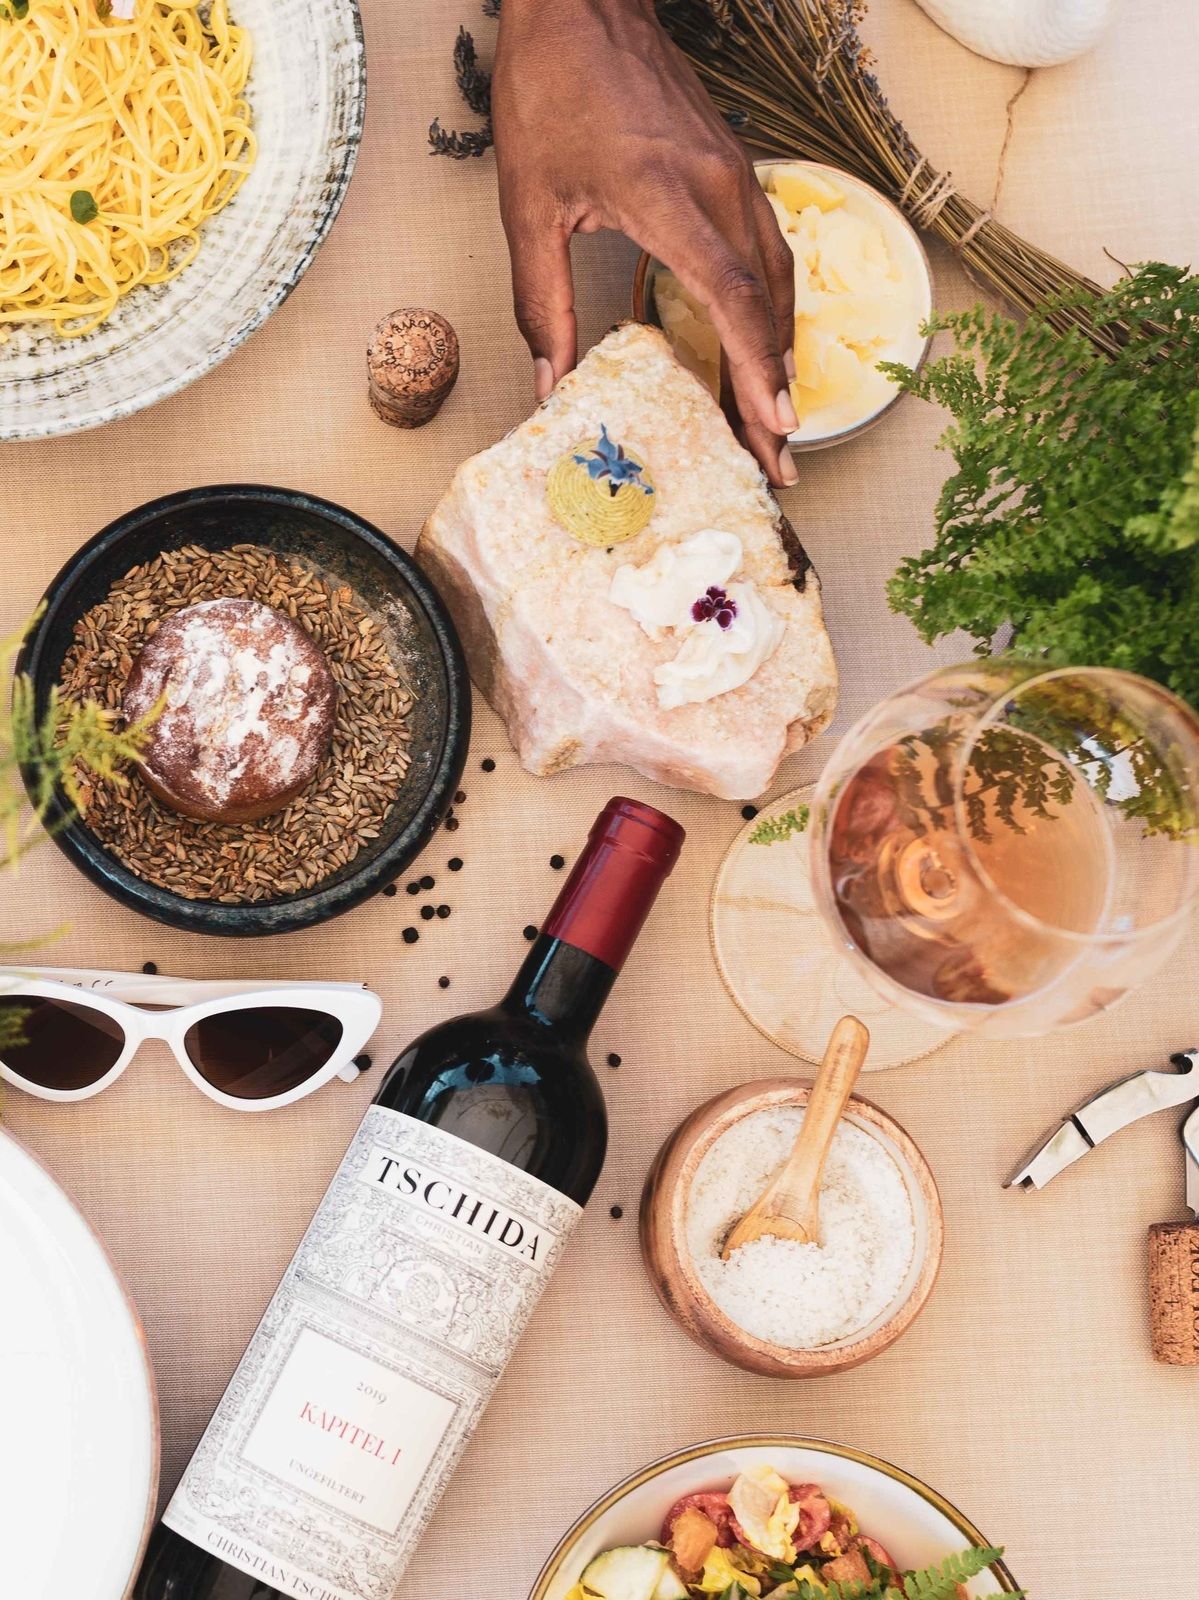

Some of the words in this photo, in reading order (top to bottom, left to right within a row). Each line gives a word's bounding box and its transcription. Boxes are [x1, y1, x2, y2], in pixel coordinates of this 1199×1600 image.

[376, 1156, 539, 1261] TSCHIDA
[415, 1213, 483, 1254] CHRISTIAN
[356, 1381, 388, 1406] 2019
[300, 1401, 385, 1460] KAPITEL
[289, 1458, 367, 1504] UNGEFILTERT
[207, 1531, 290, 1582] CHRISTIAN
